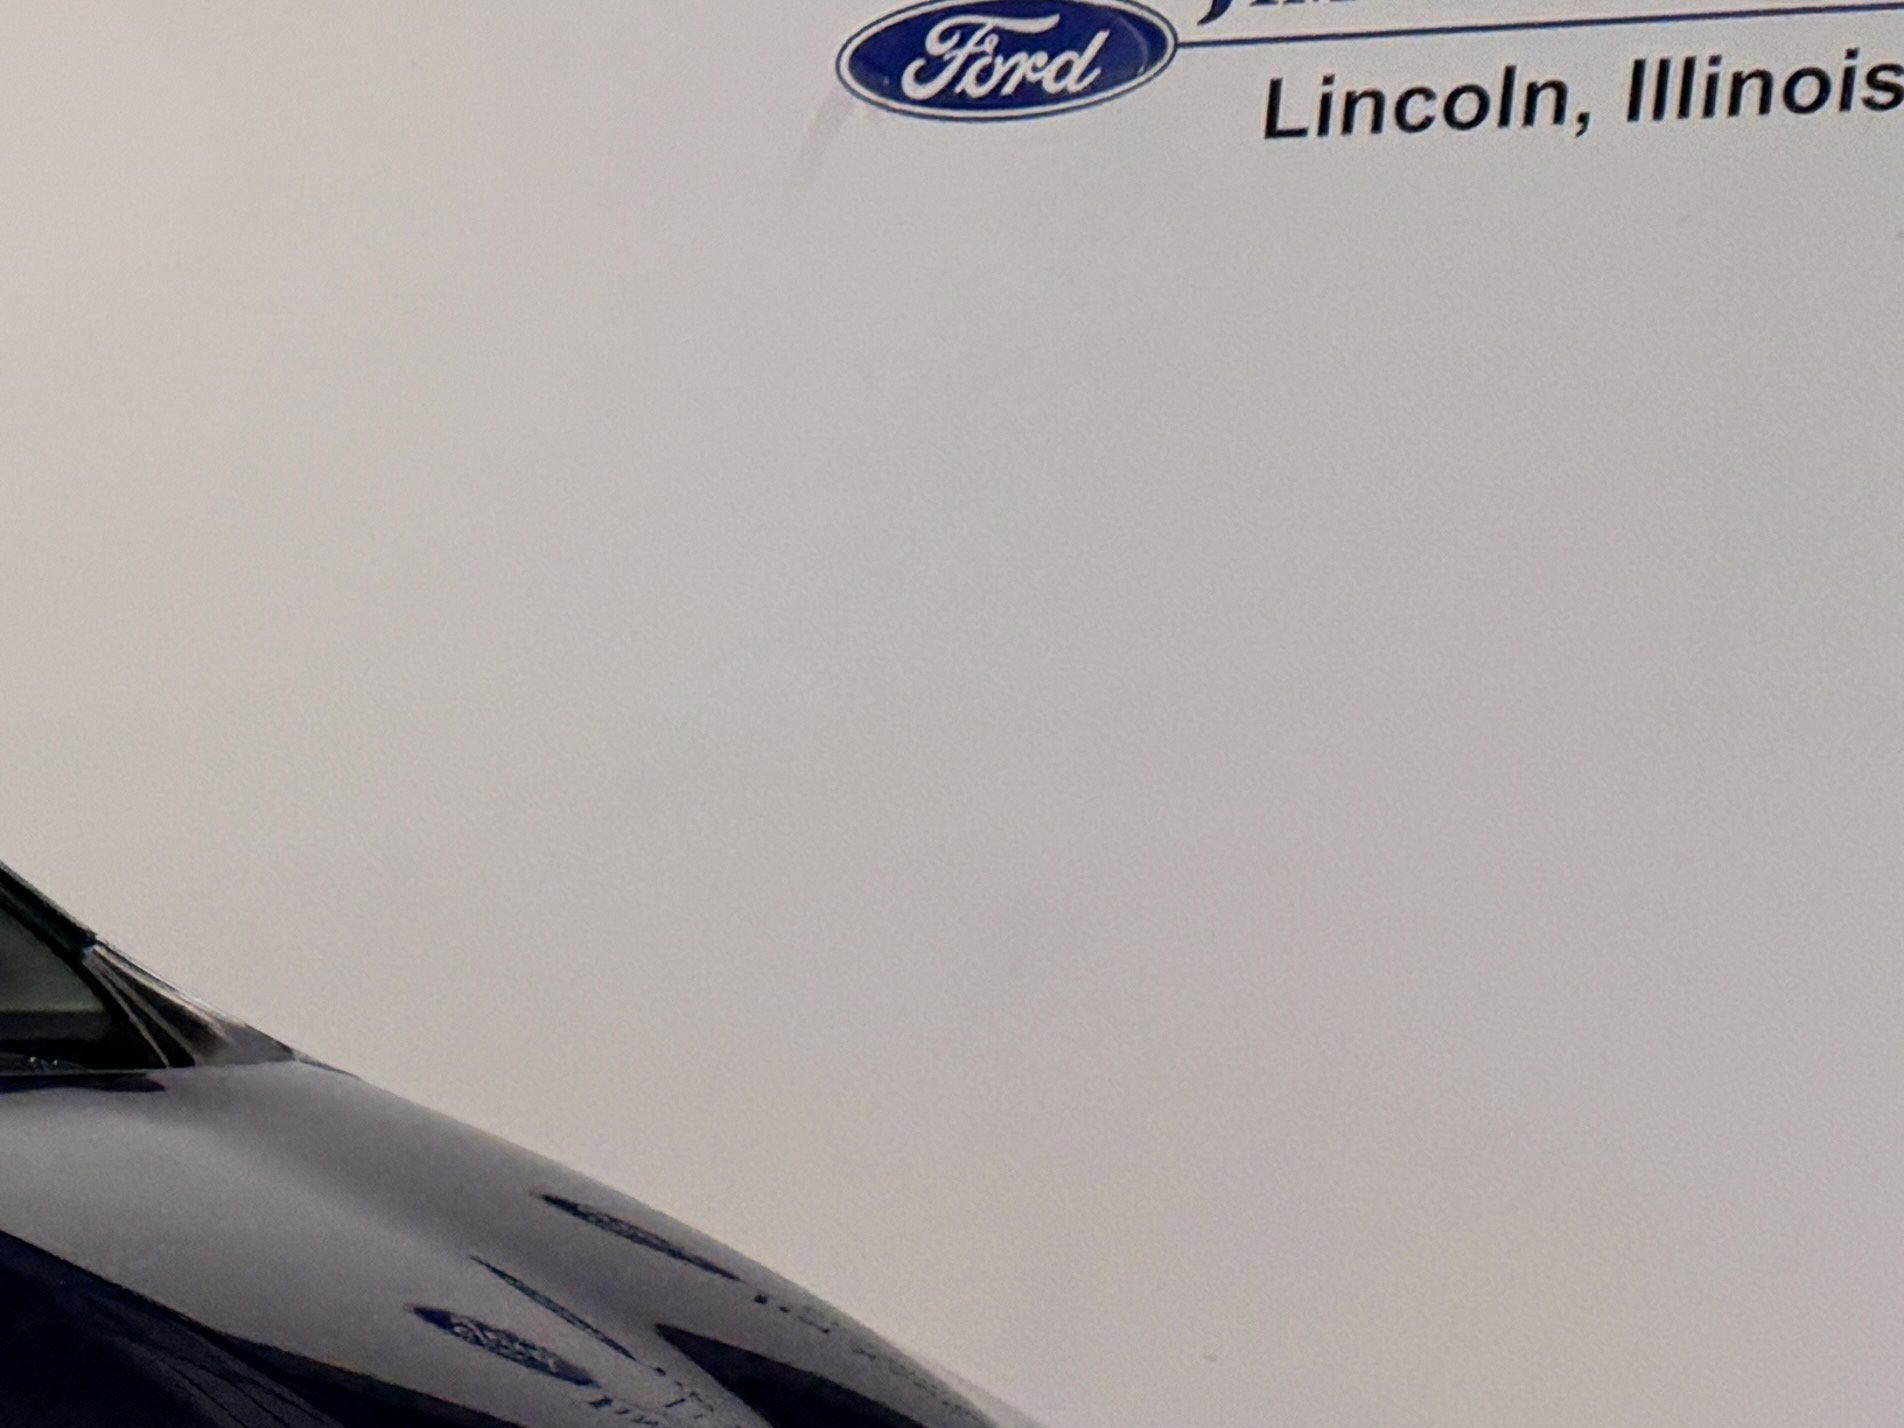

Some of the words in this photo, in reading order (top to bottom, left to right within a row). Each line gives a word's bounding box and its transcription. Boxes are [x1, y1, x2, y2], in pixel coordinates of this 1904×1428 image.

[901, 13, 1111, 101] Ford
[1262, 65, 1591, 139] Lincoln,
[1627, 47, 1904, 122] Illinois
